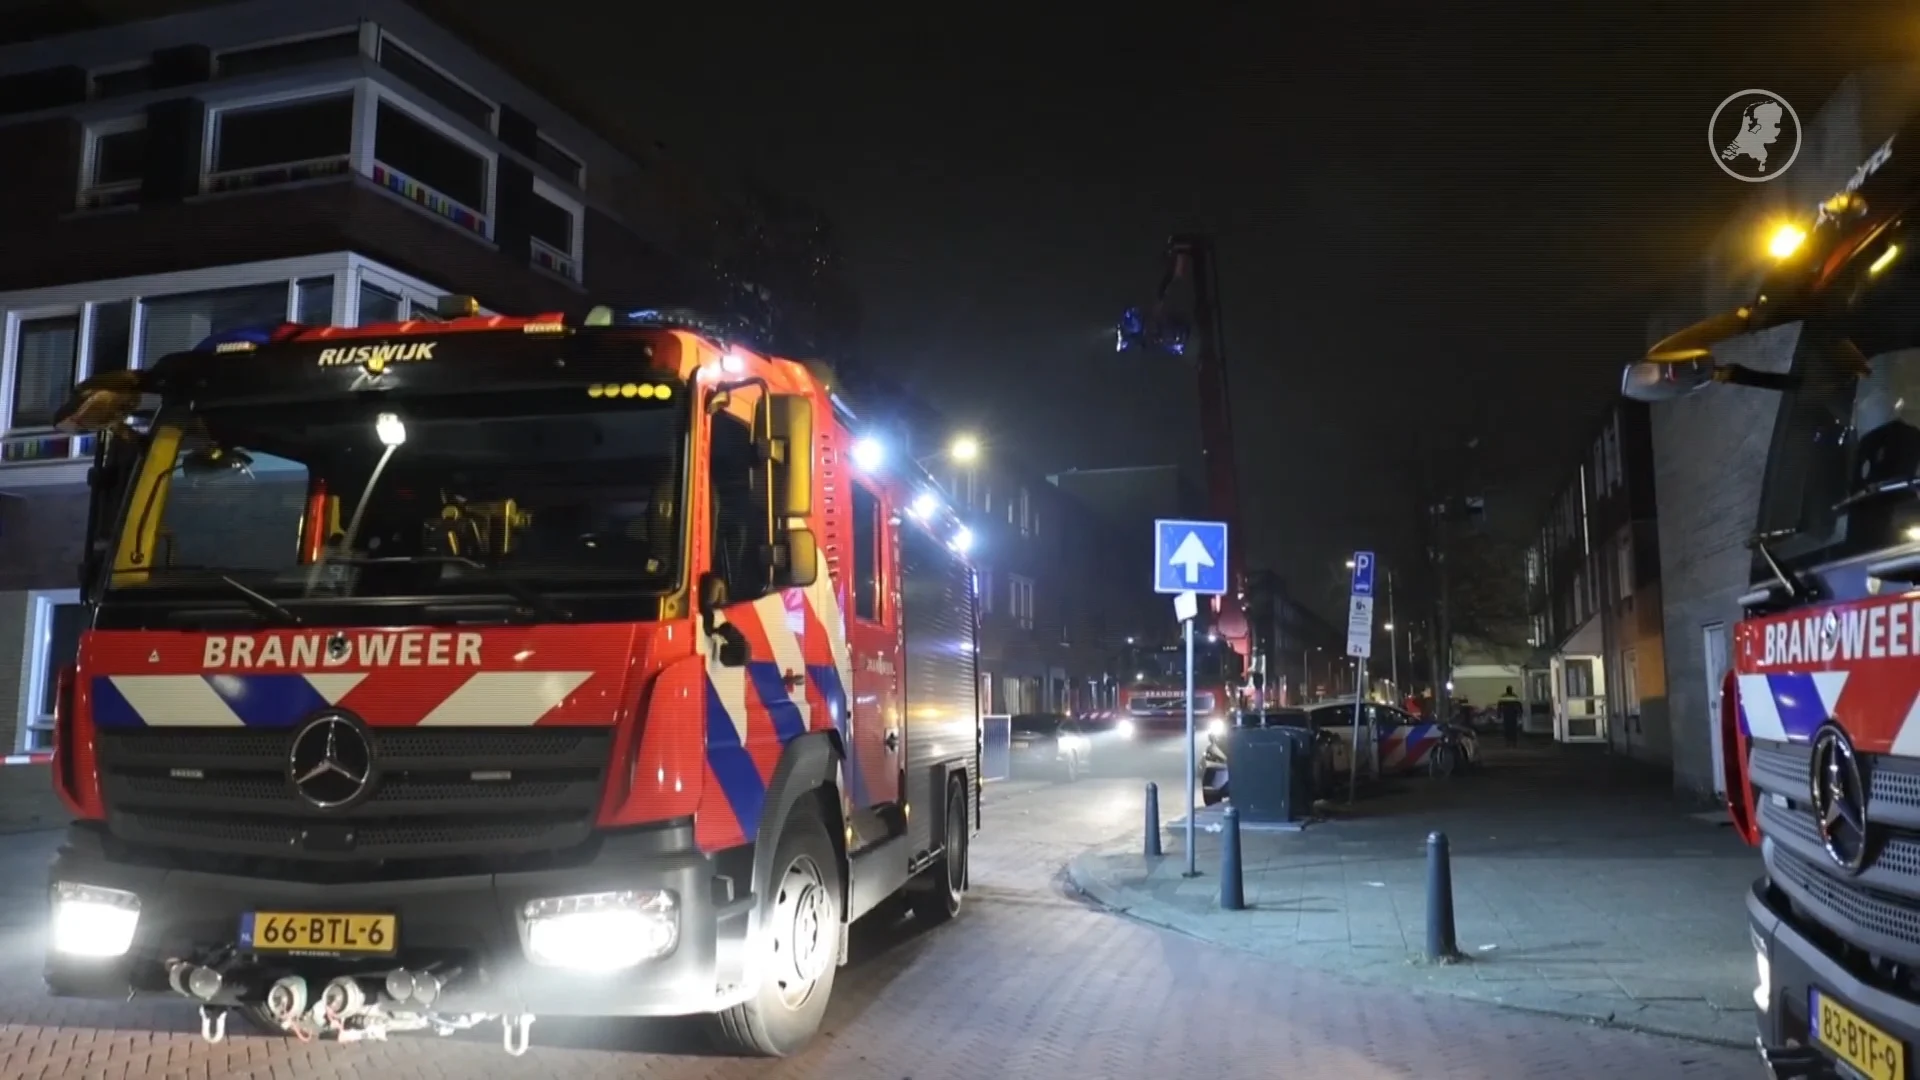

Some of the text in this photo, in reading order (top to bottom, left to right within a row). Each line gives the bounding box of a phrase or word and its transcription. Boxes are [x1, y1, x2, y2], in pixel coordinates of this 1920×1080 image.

[318, 342, 437, 366] RIJSWIJK
[1357, 555, 1369, 577] P
[203, 632, 482, 668] BRANDWEER
[264, 917, 384, 946] 66-BTL-6
[1824, 1004, 1896, 1080] 83-BTF-9
